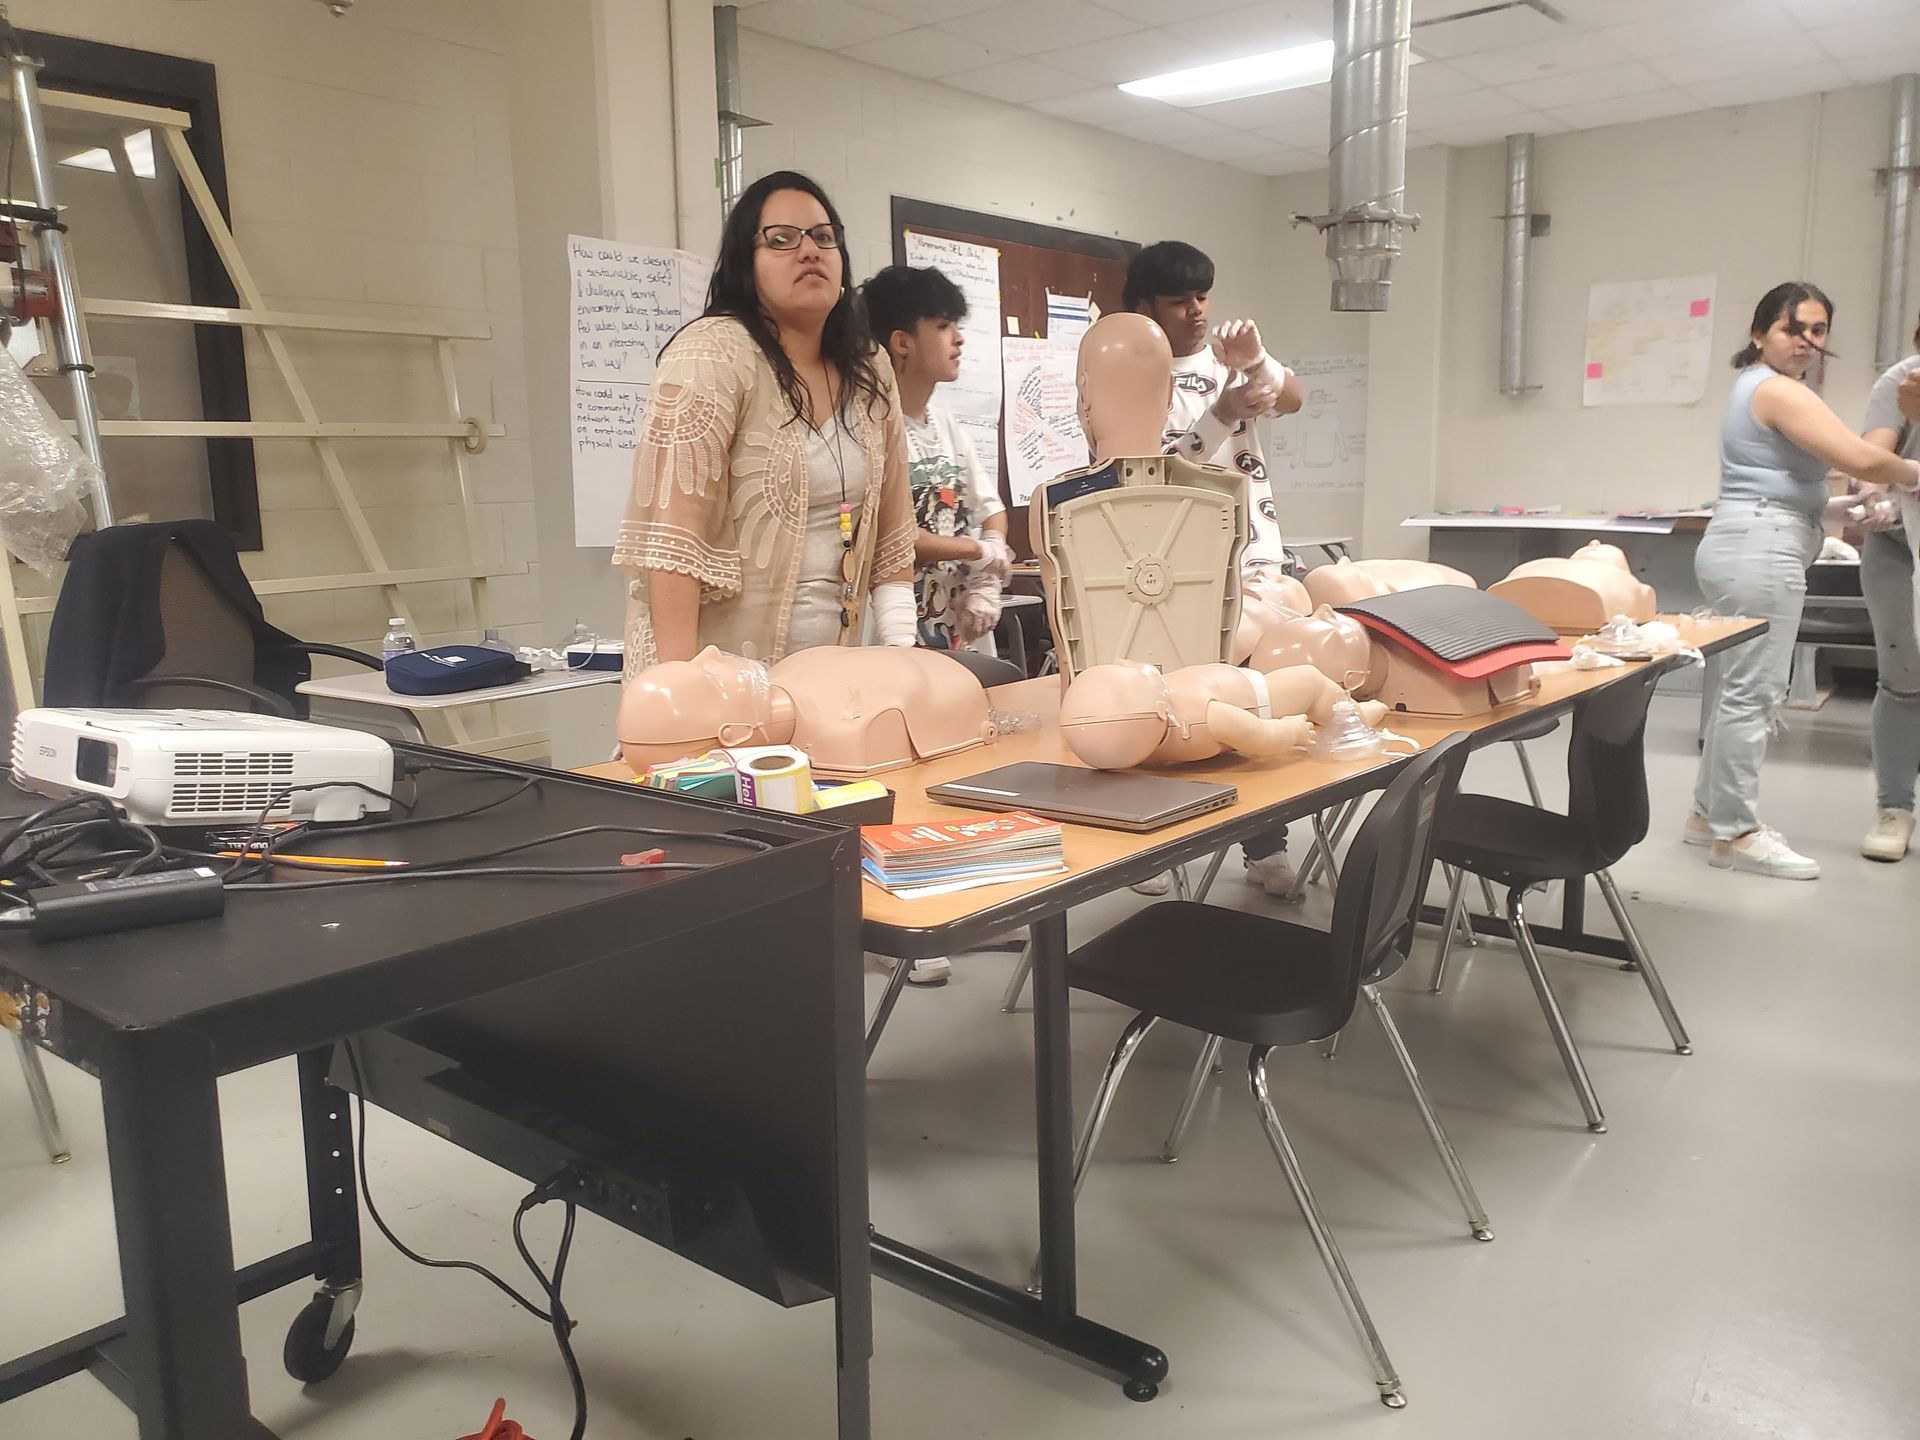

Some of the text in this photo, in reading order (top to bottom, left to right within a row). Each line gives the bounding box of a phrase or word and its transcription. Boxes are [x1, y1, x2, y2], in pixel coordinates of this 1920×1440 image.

[573, 242, 593, 258] How
[598, 250, 623, 261] could
[643, 256, 676, 270] design
[1175, 376, 1207, 392] FILA
[575, 386, 592, 397] How
[635, 392, 648, 402] bu
[577, 414, 635, 425] network that
[594, 426, 636, 436] emotional
[579, 437, 612, 453] physical
[741, 776, 754, 806] Hell
